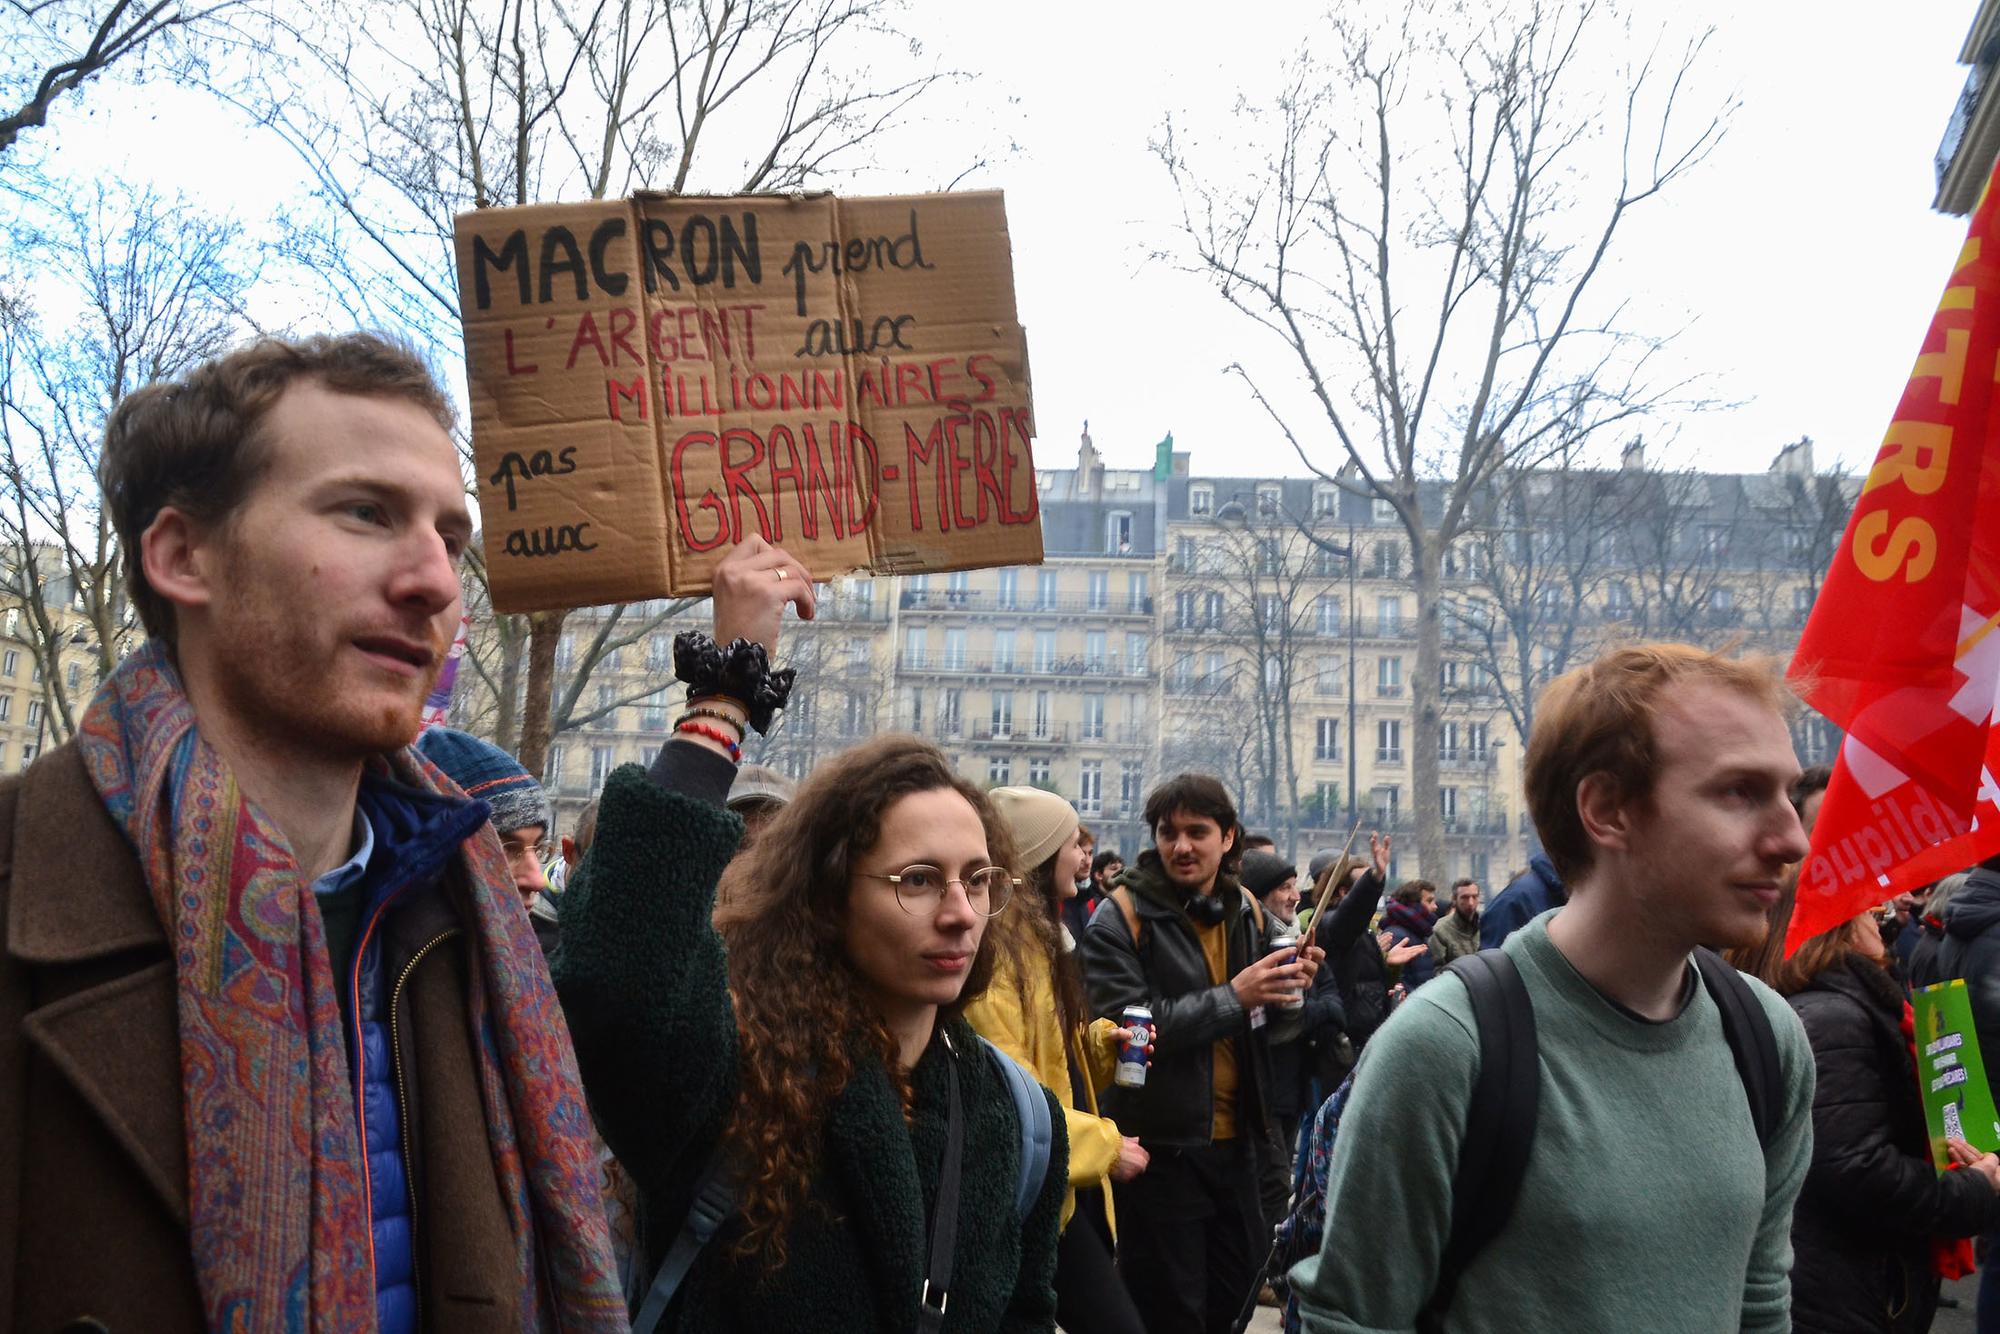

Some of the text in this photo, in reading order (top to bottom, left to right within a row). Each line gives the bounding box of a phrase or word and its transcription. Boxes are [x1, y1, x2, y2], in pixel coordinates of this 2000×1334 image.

[472, 208, 936, 317] MACRON prend
[504, 303, 915, 376] L'ARGENT aux
[490, 444, 580, 512] pas
[500, 522, 600, 558] aux
